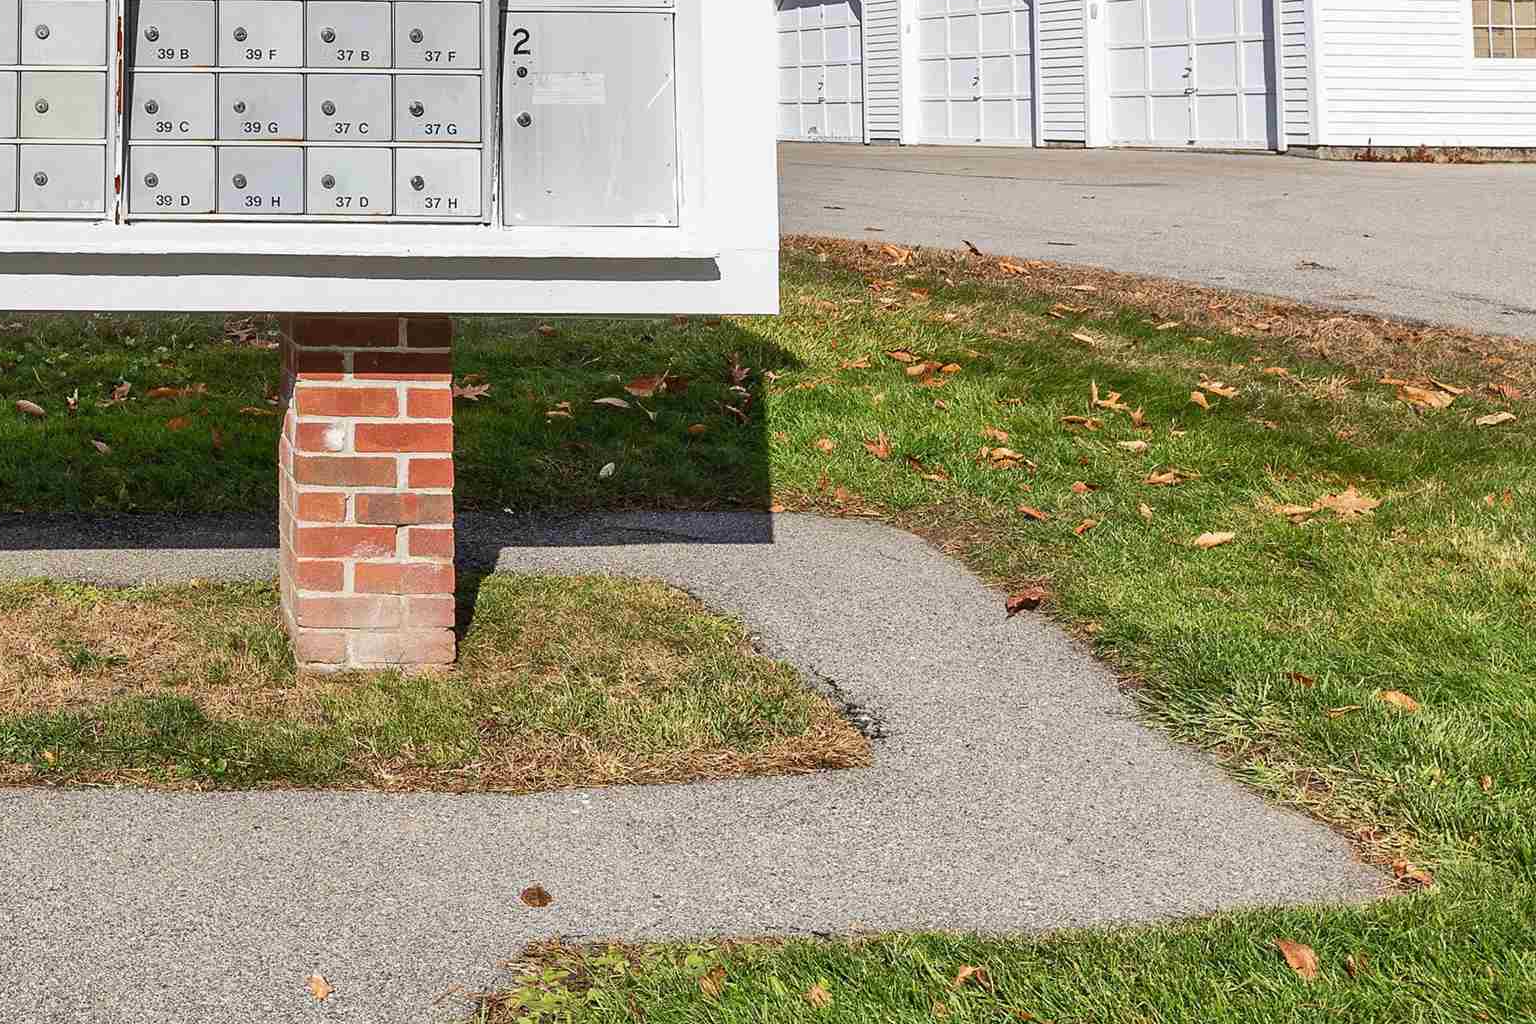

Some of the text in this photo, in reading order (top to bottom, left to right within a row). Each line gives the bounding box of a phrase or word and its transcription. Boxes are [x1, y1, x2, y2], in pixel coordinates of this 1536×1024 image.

[512, 28, 531, 55] 2
[157, 48, 190, 60] 39 B
[245, 48, 277, 61] 39 F
[336, 49, 370, 62] 37 B
[424, 50, 457, 63] 37 F
[155, 120, 190, 133] 39 C
[243, 121, 279, 134] 39 G
[334, 122, 369, 135] 37 C
[424, 123, 458, 136] 37 G
[155, 194, 191, 207] 39 D
[244, 195, 281, 208] 39 H
[335, 196, 369, 208] 37 D
[424, 196, 458, 209] 37 H
